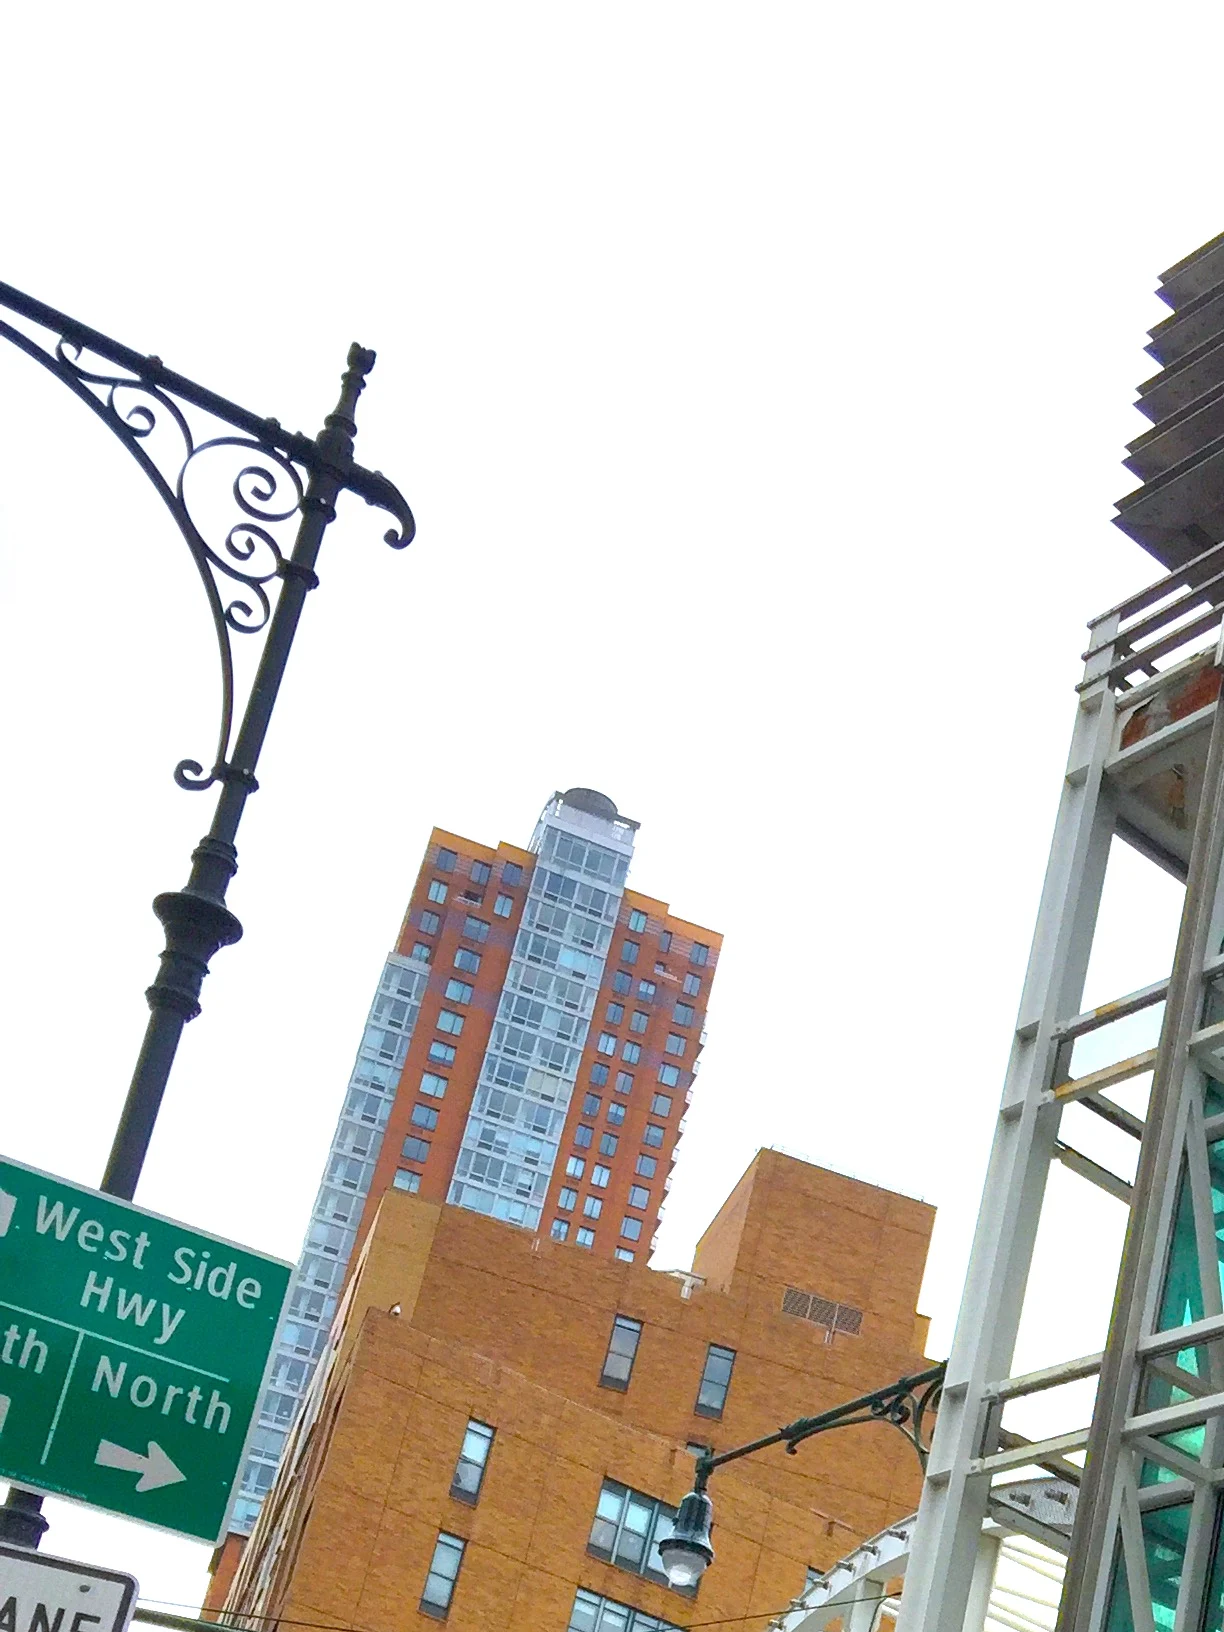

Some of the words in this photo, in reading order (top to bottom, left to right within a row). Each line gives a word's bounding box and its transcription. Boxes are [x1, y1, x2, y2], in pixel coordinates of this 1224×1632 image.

[35, 1195, 150, 1270] West
[167, 1247, 262, 1310] Side
[80, 1270, 186, 1345] Hwy
[91, 1354, 232, 1434] North
